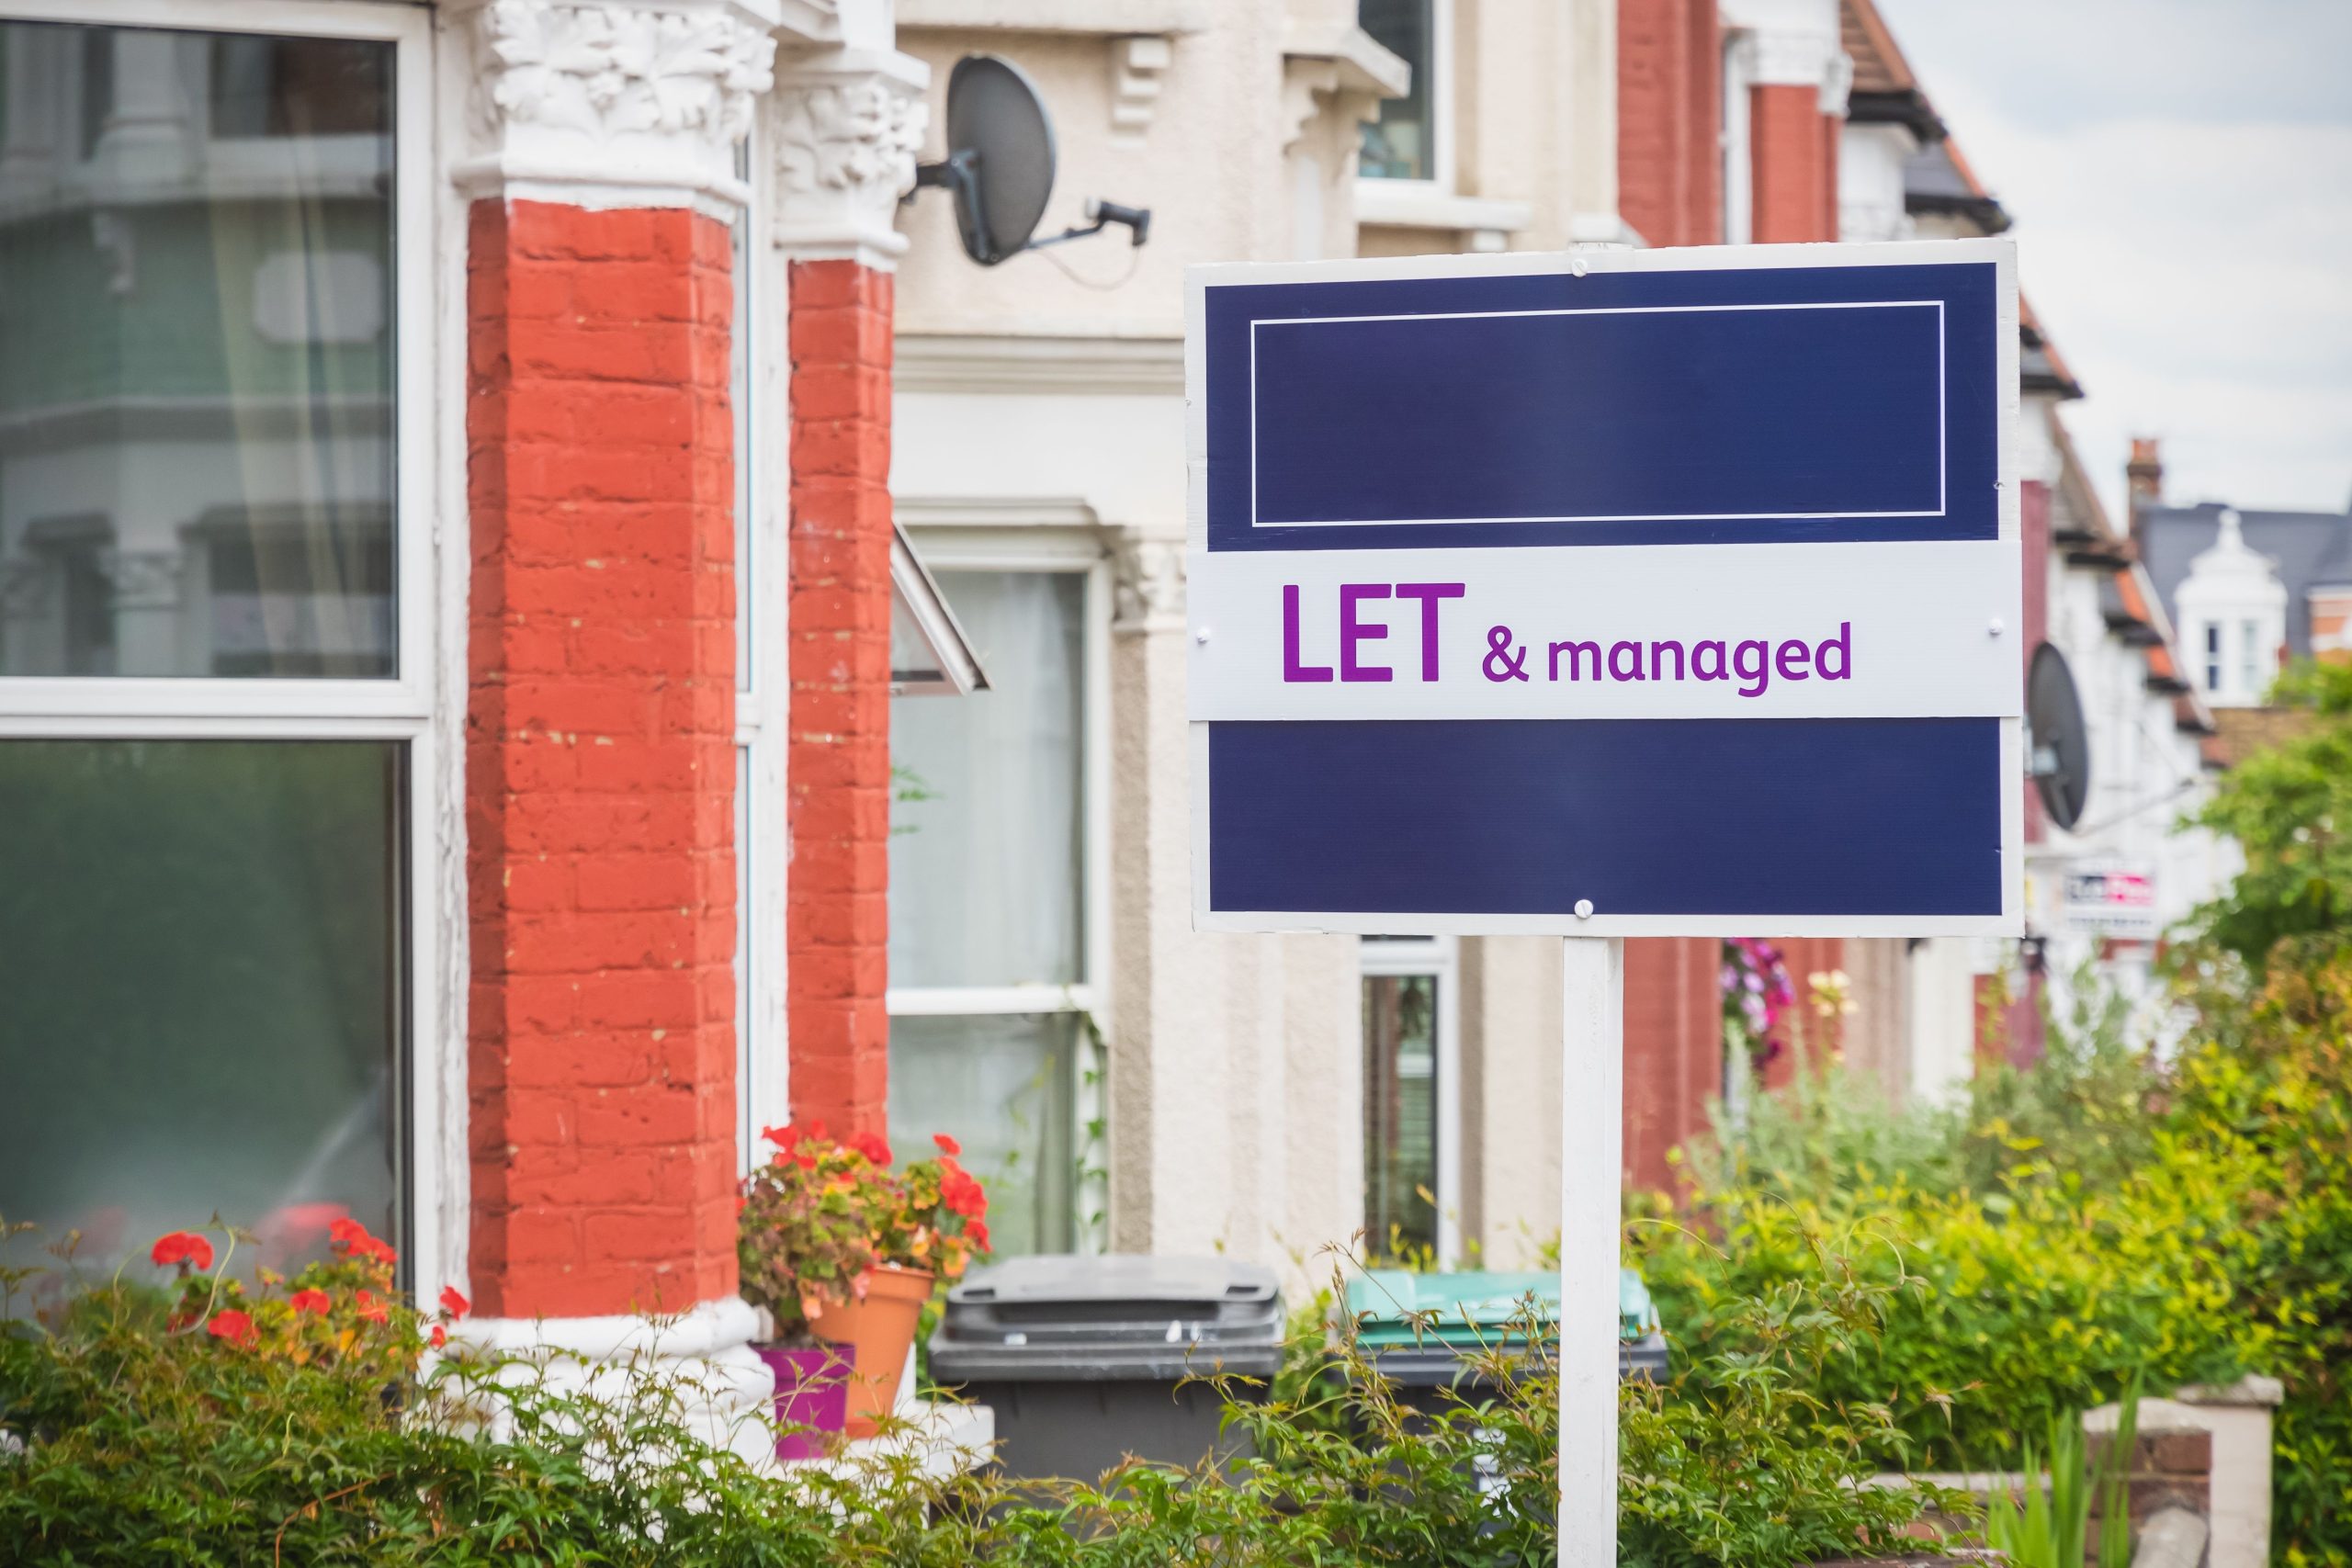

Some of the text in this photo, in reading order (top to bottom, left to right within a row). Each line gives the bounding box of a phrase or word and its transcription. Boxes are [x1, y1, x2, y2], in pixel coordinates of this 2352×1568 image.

[1283, 582, 1851, 698] LET & managed
